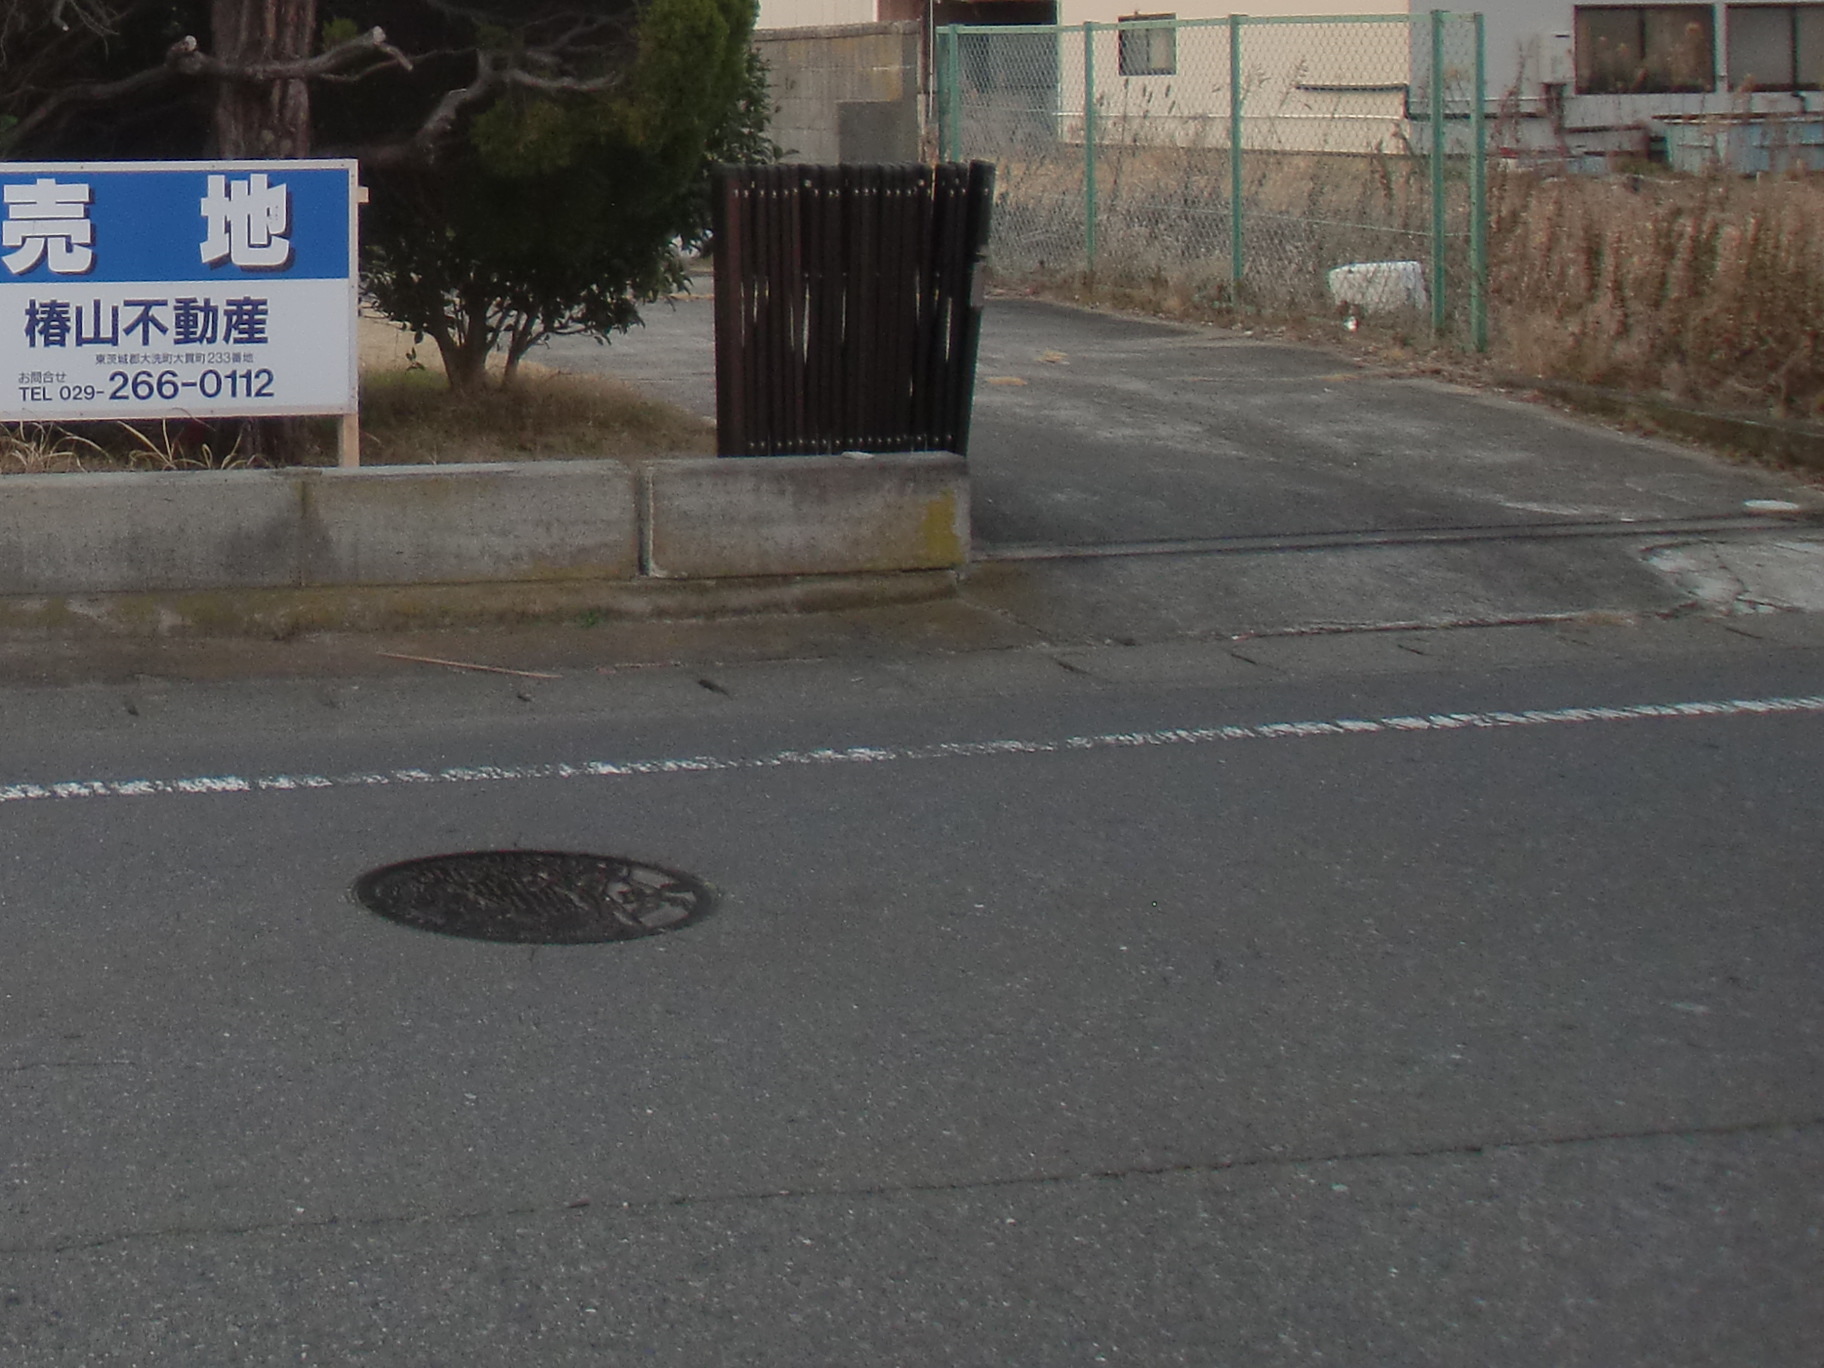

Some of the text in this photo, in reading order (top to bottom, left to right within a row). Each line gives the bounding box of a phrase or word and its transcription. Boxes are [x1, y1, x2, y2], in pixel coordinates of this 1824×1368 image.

[24, 296, 269, 348] 椿山不動産
[17, 372, 67, 384] お問合せ
[19, 387, 52, 402] TEL
